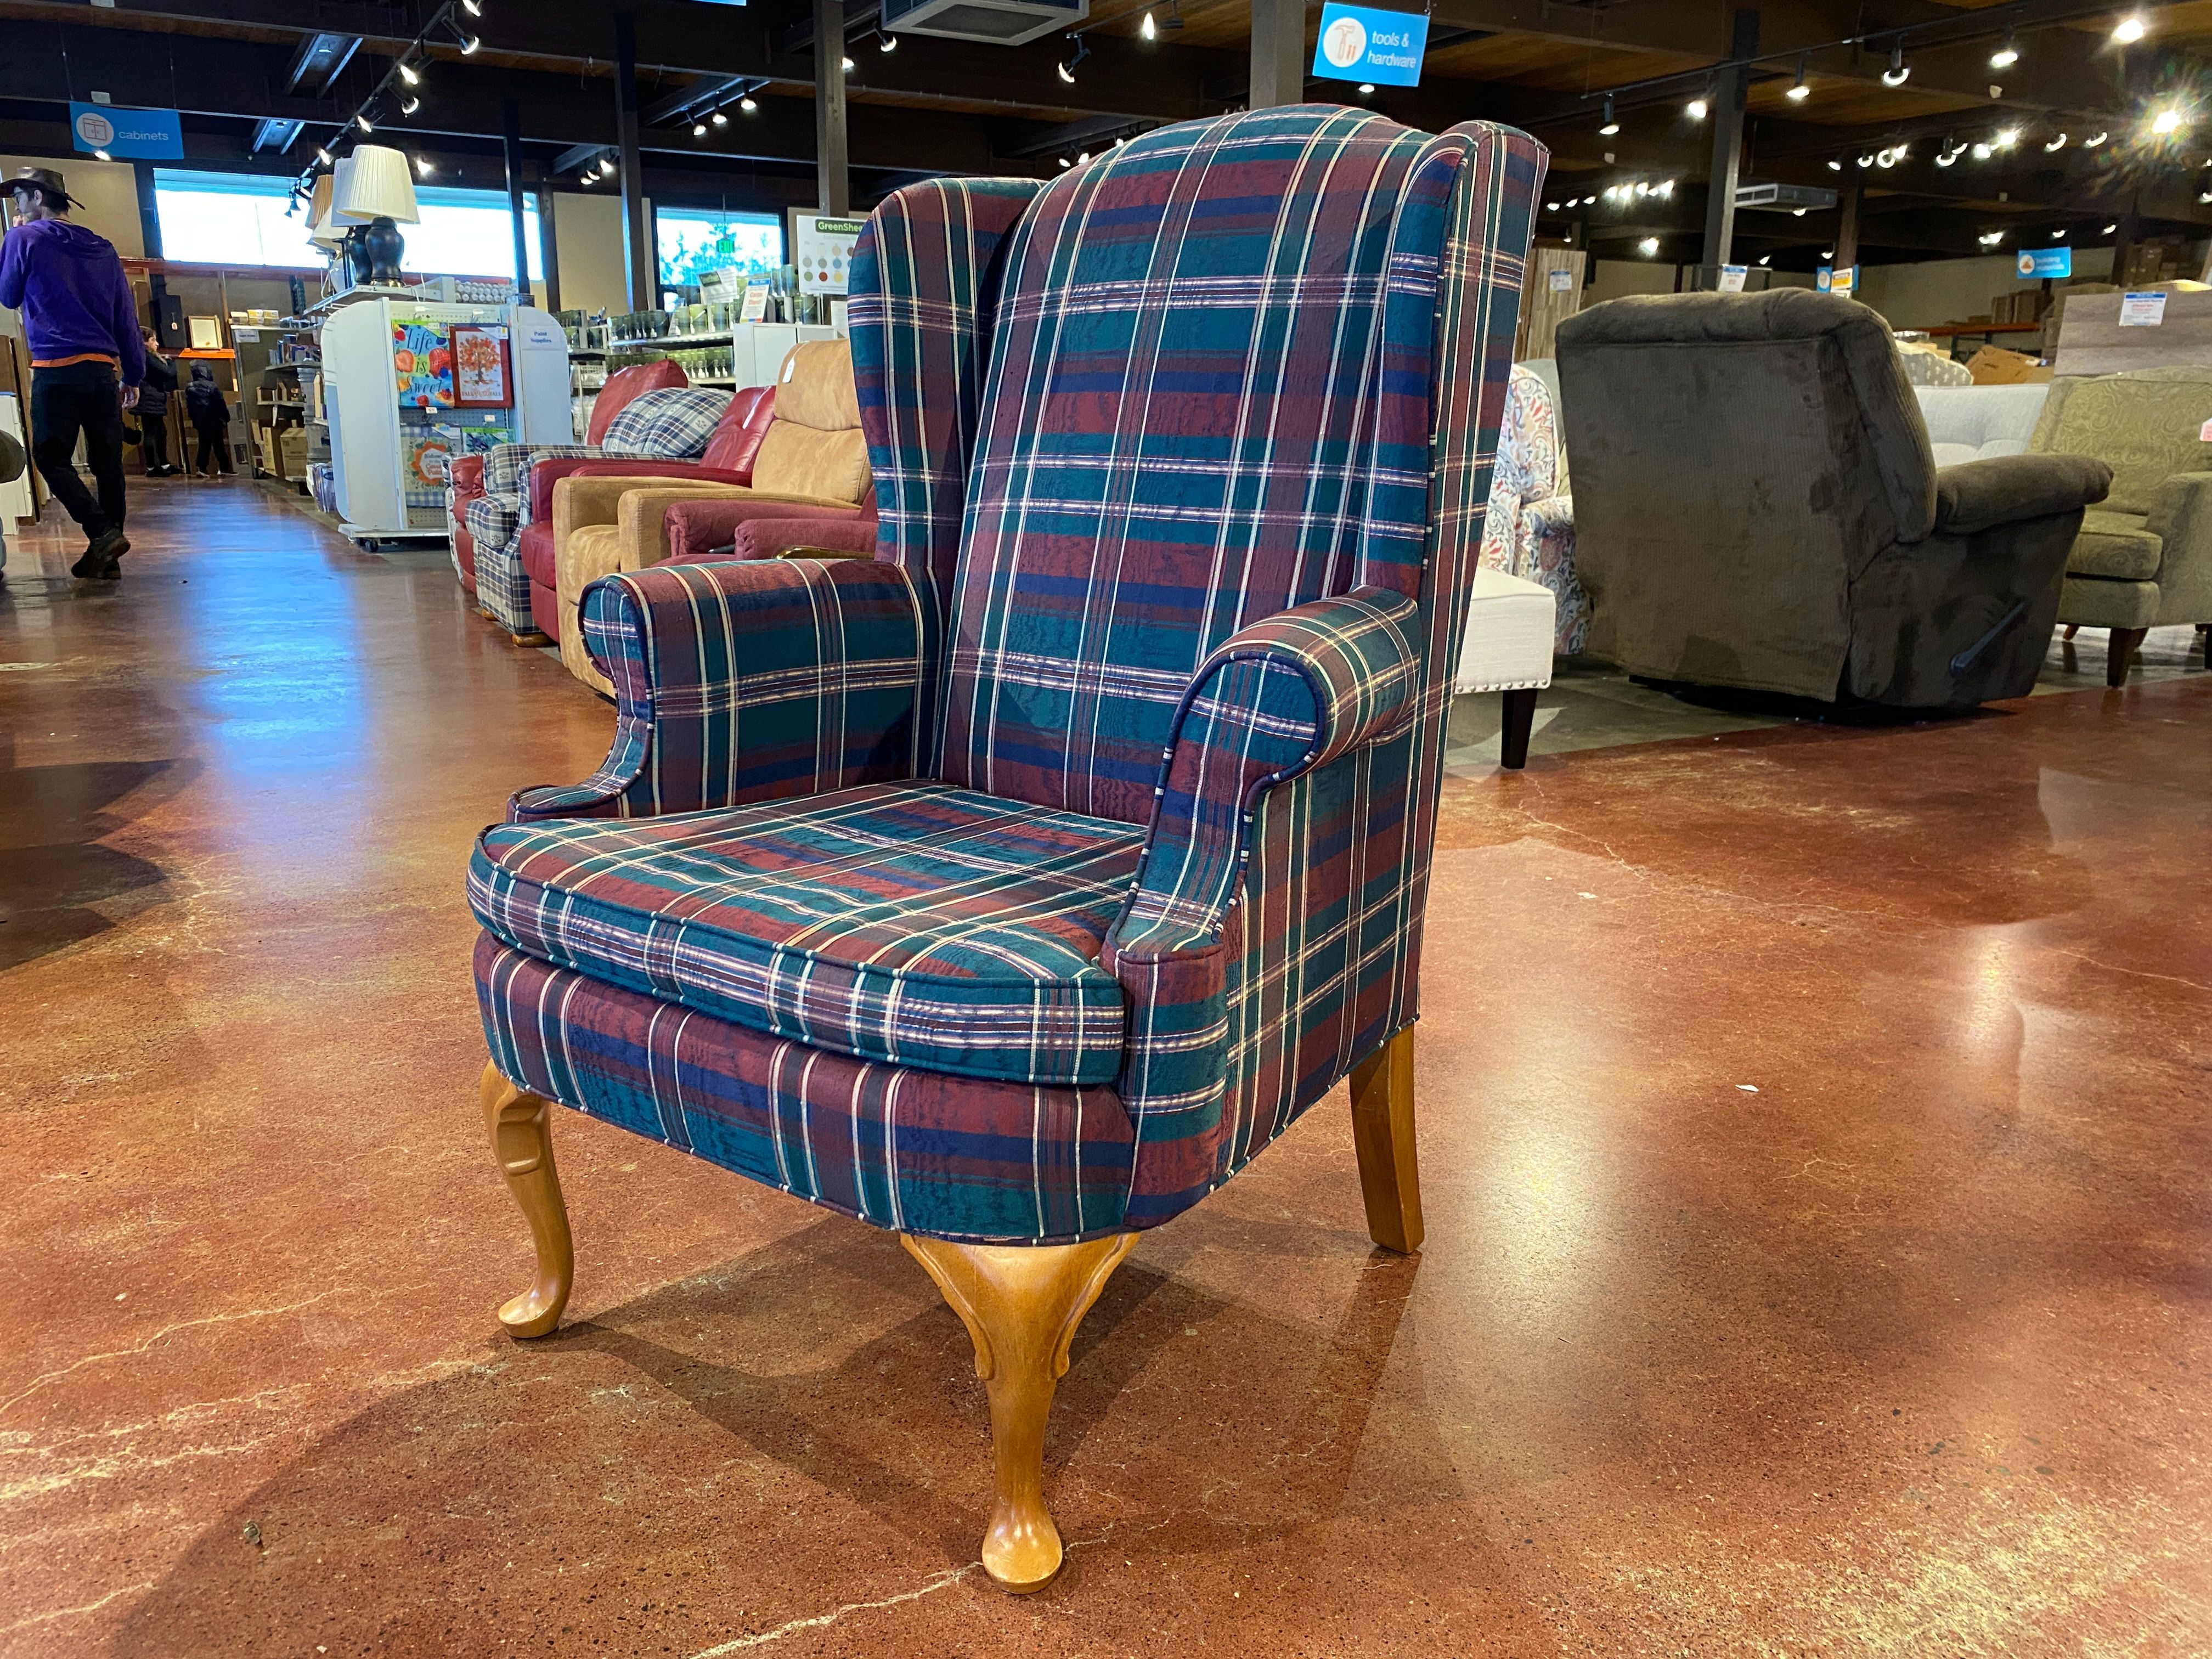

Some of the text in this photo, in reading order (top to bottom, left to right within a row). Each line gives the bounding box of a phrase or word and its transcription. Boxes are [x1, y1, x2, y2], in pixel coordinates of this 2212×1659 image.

[1372, 31, 1409, 48] tools &
[1367, 50, 1417, 68] hardware
[119, 131, 169, 140] cabinets
[818, 221, 863, 232] GreenShee
[407, 329, 432, 356] Life
[415, 357, 427, 374] is
[405, 376, 442, 394] Sweet
